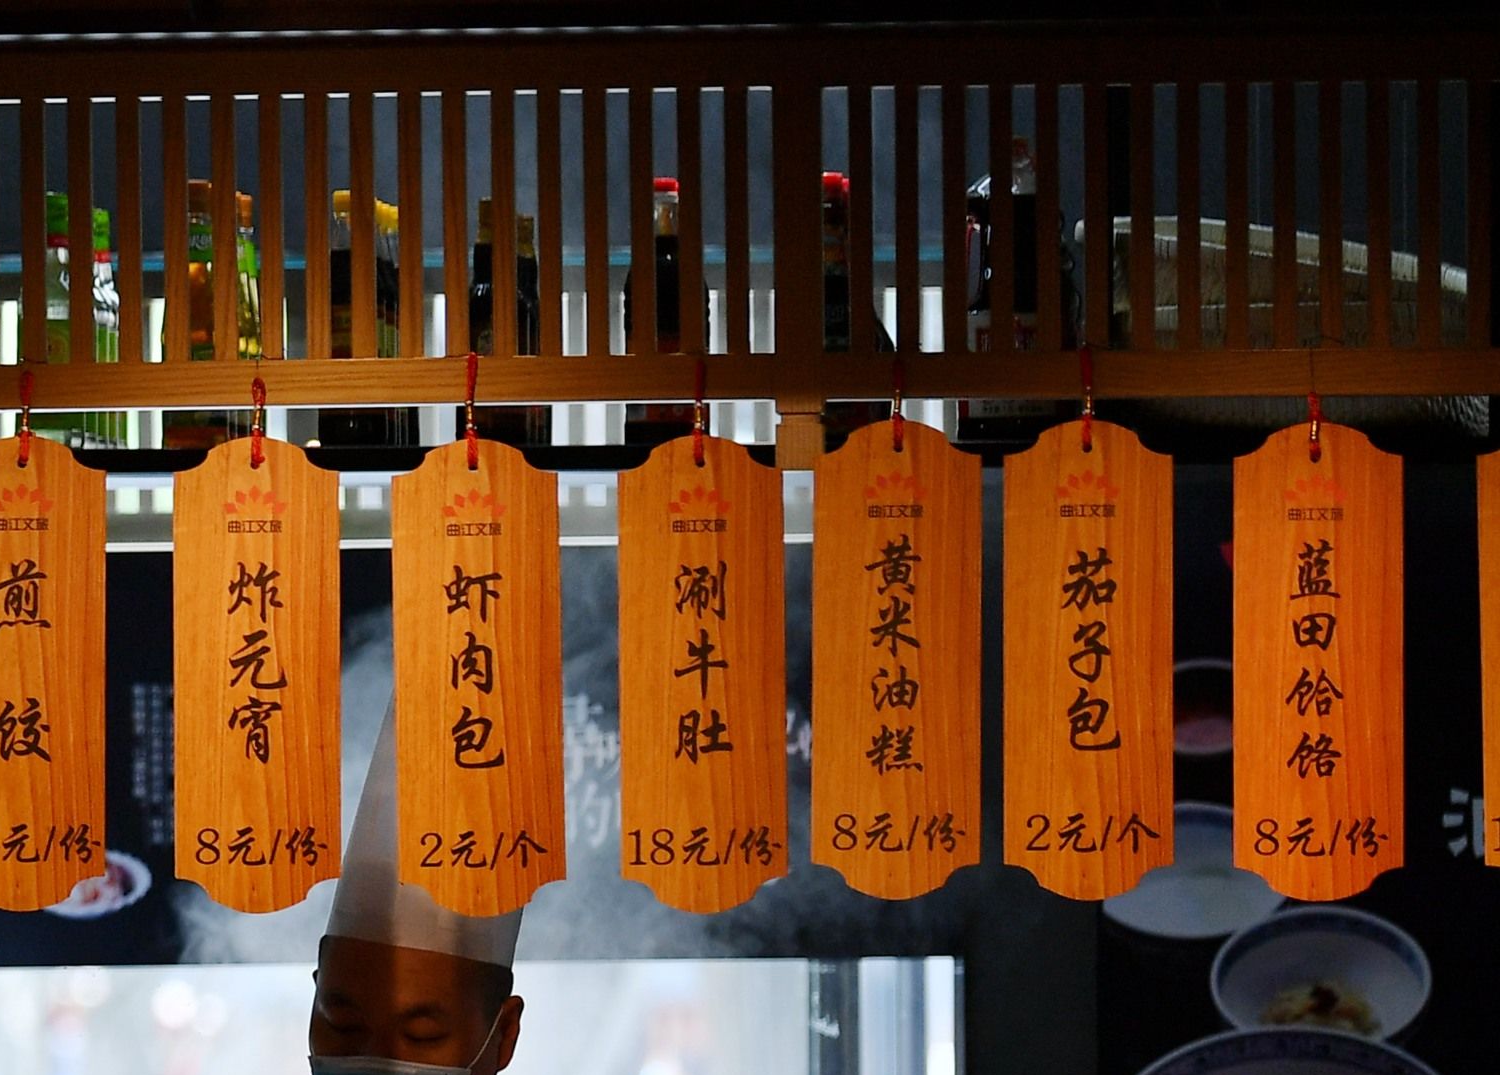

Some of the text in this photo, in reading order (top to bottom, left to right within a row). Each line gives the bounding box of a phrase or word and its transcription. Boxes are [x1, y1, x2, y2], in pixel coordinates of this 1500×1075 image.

[227, 519, 282, 534] 曲江文旅
[446, 522, 502, 537] 曲江文旅
[672, 518, 727, 533] 曲江文旅
[867, 504, 924, 519] 曲江文旅
[1059, 503, 1116, 518] 曲江文旅
[1288, 507, 1343, 521] 曲江文旅
[227, 562, 288, 764] 炸元宵
[444, 565, 505, 769] 虾肉包
[674, 560, 734, 764] 涮牛肚
[864, 534, 923, 775] 黄米油糕
[1062, 547, 1122, 751] 茄子包
[1286, 539, 1344, 779] 蓝田饸饹
[195, 826, 328, 866] 8元/份
[420, 830, 548, 870] 2元/个
[630, 826, 781, 866] 18元/份
[832, 812, 965, 853] 8元/份
[1026, 813, 1160, 854] 2元/个
[1254, 817, 1388, 858] 8元/份
